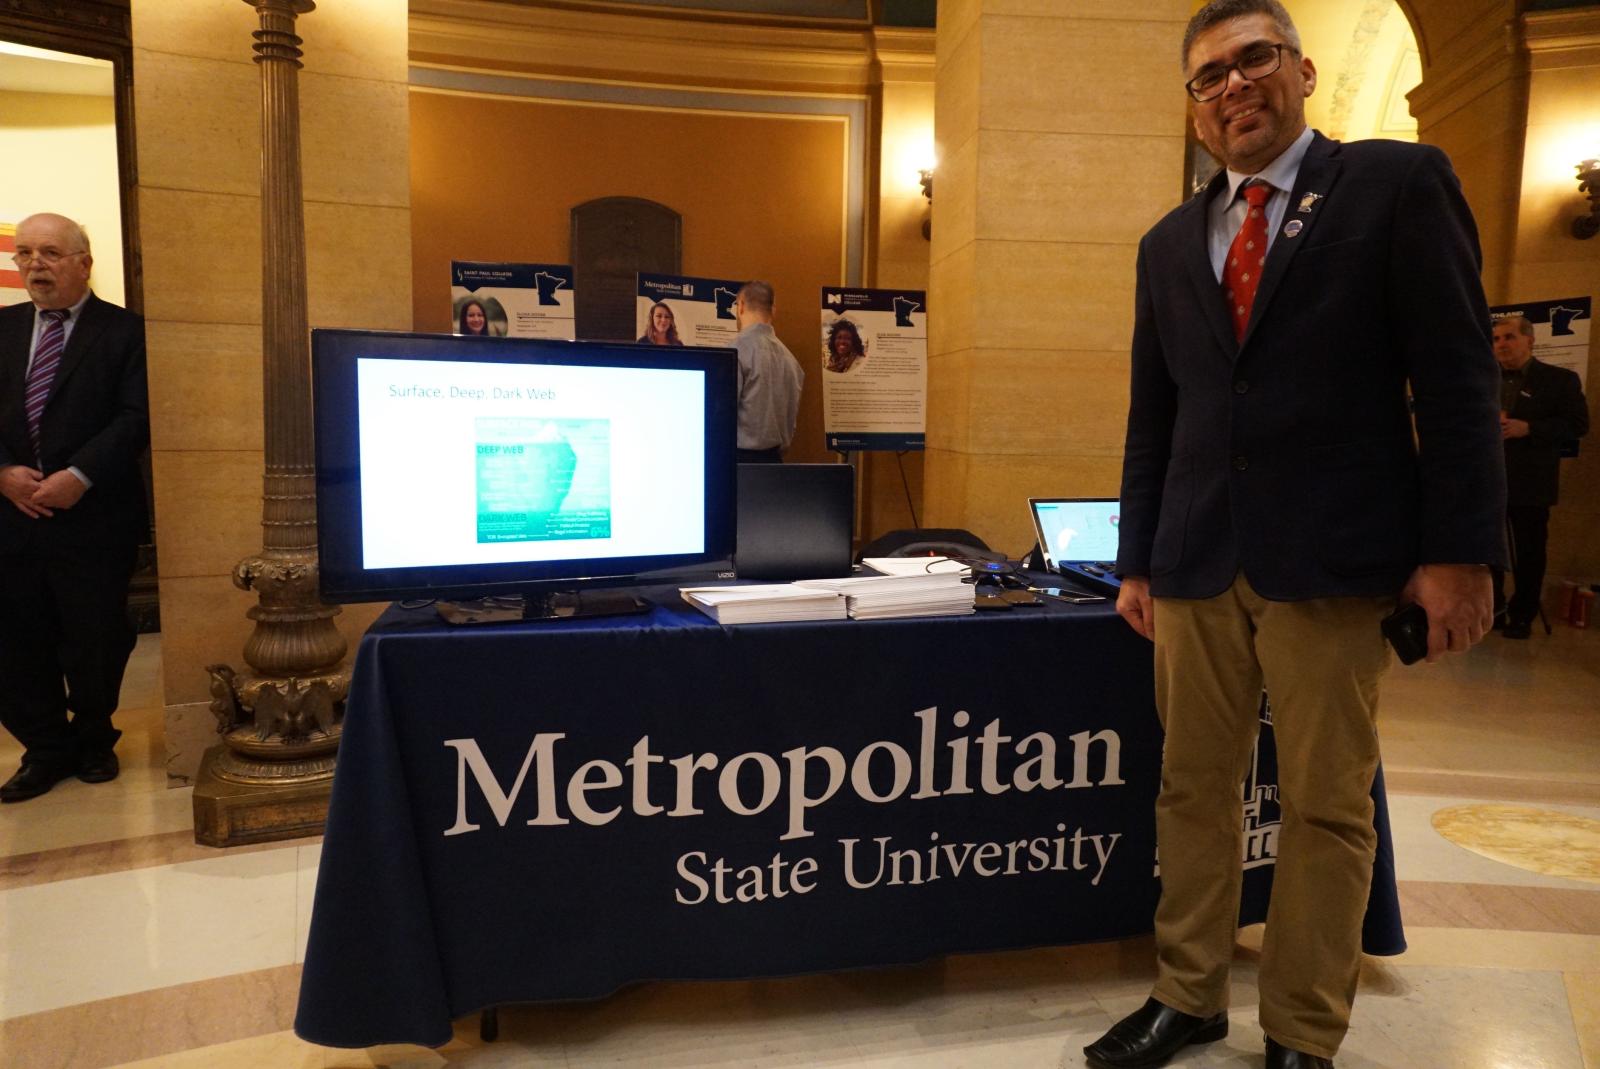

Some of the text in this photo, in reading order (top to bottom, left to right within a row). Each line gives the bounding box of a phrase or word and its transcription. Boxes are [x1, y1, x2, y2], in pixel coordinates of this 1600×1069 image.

[644, 281, 682, 290] Metropolitan
[389, 384, 556, 401] Surface, Deep, Dark Web
[477, 445, 524, 454] DEEP WEB
[479, 513, 527, 522] DARK WEB
[443, 705, 1126, 841] Metropolitan
[675, 823, 1122, 905] State University
